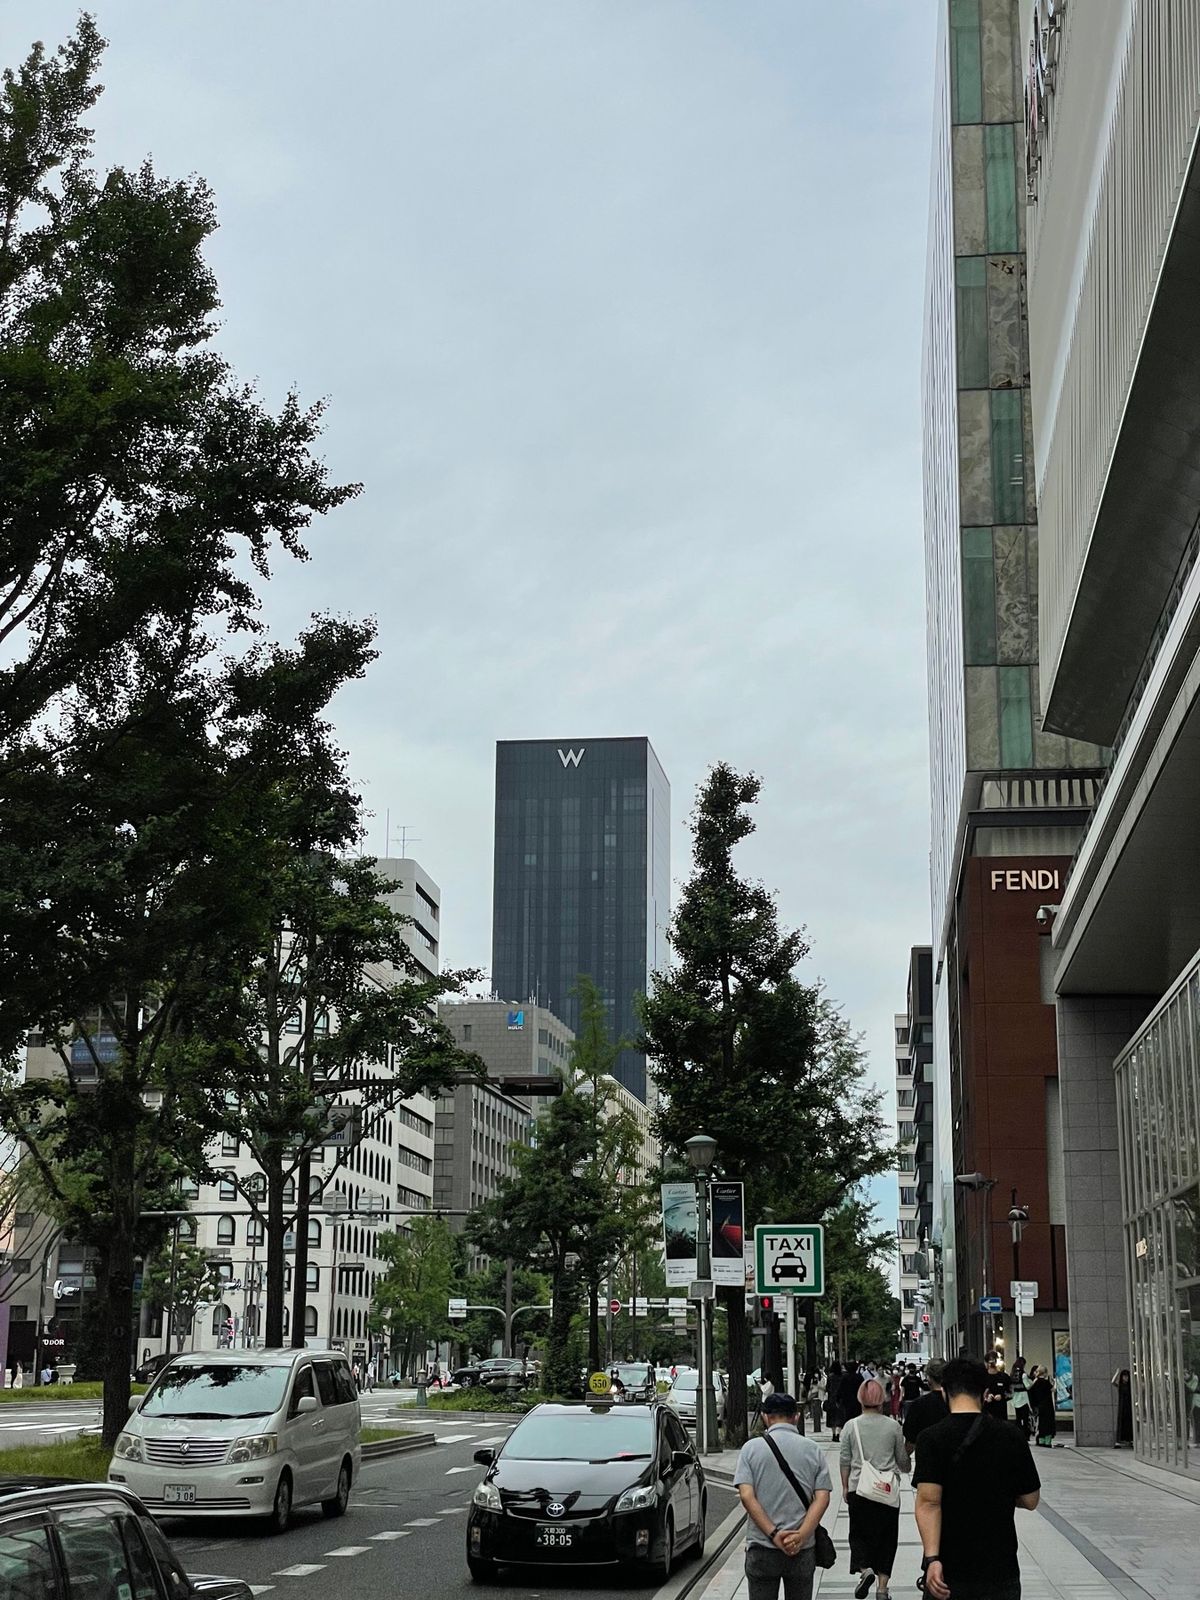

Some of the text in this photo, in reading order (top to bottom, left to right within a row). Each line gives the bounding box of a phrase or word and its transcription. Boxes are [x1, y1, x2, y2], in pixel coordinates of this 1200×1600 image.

[557, 748, 585, 768] W
[991, 869, 1059, 890] FENDI
[766, 1238, 810, 1250] TAXI
[592, 1379, 607, 1388] 550
[543, 1535, 572, 1545] 38-05
